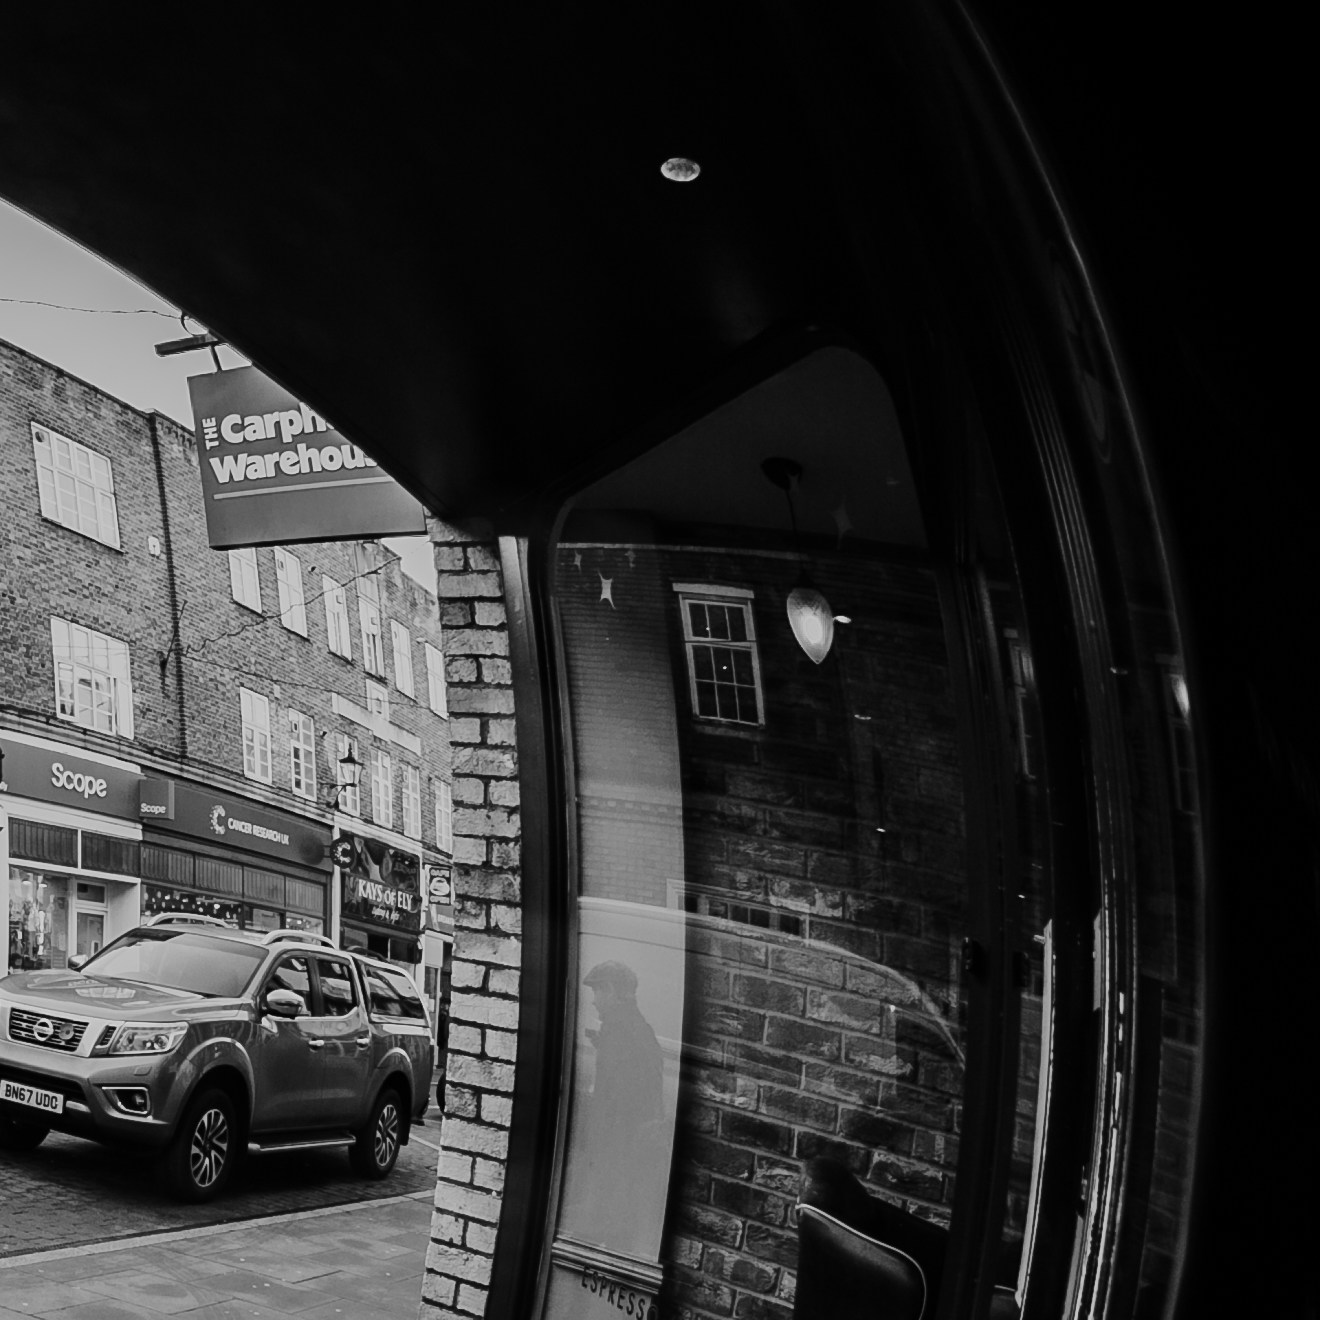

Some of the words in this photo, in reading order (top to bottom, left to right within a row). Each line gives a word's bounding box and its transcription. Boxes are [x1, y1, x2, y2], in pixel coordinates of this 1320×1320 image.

[202, 416, 220, 450] THE
[51, 762, 107, 799] Scope
[140, 802, 167, 815] Scope
[227, 817, 252, 835] CANCER
[358, 879, 383, 902] KAYS
[397, 890, 413, 912] ELY
[5, 1083, 34, 1104] BN67
